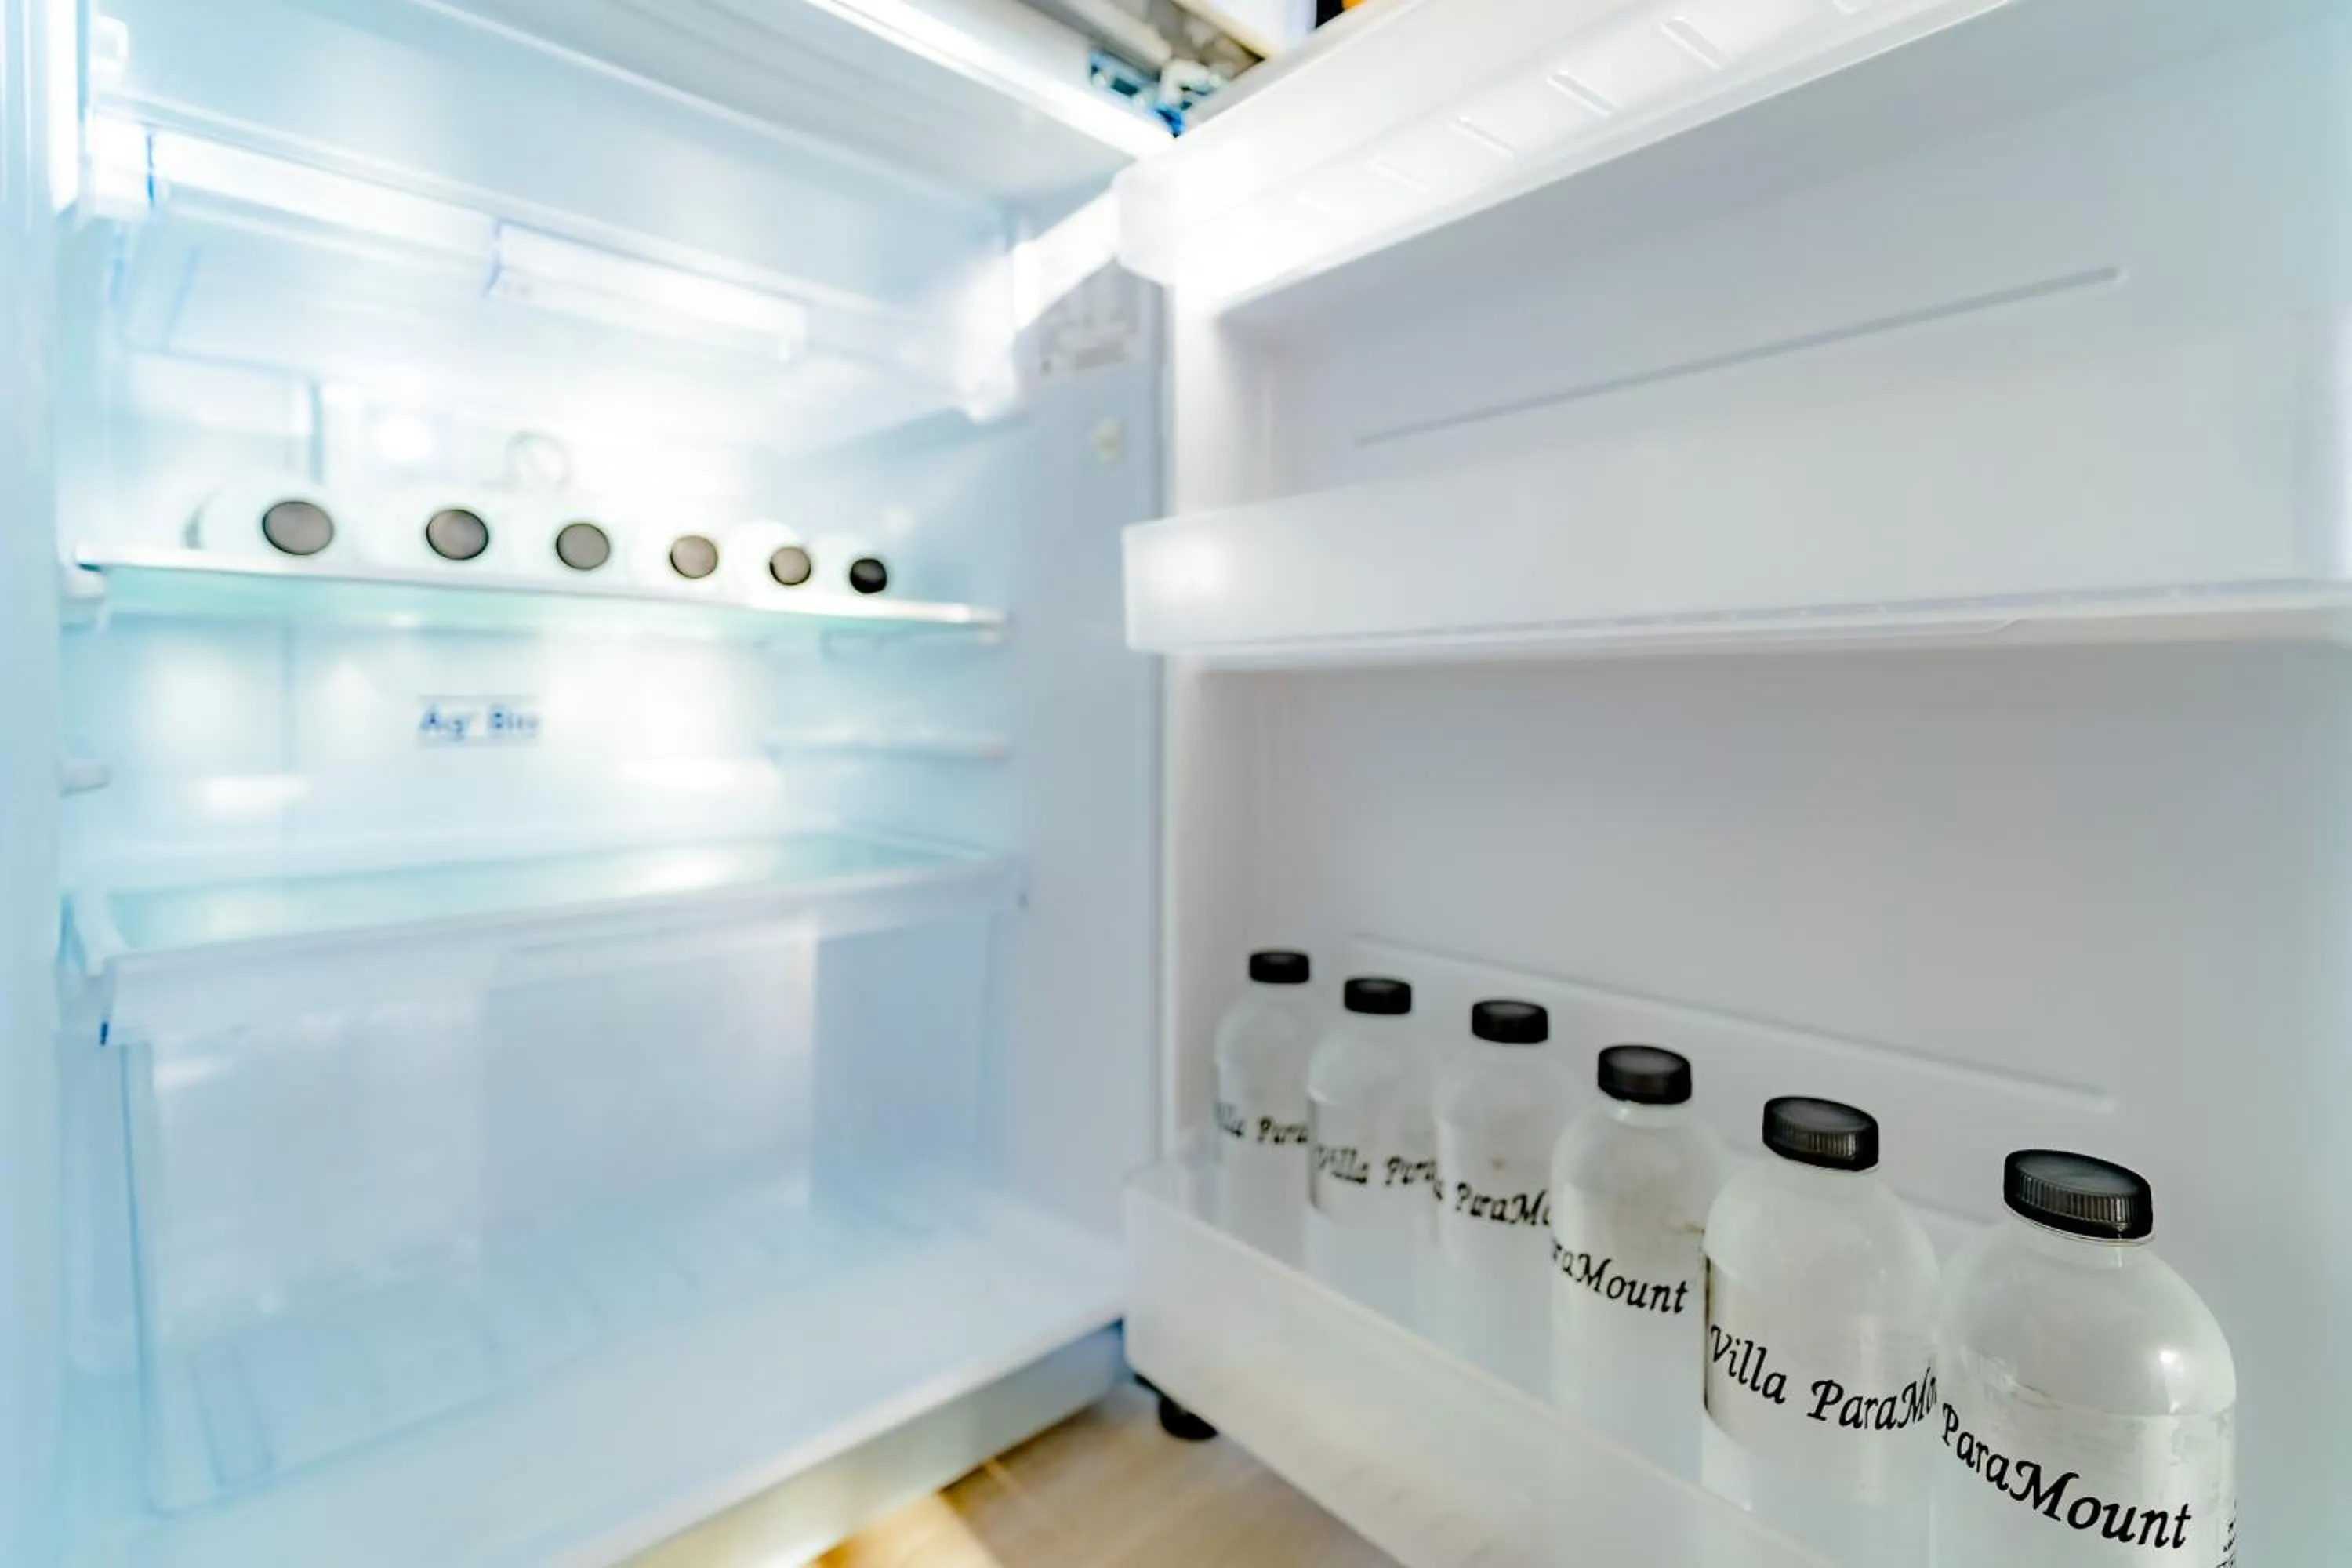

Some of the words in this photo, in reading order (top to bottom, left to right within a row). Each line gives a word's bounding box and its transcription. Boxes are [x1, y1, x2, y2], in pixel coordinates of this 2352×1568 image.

[1552, 1236, 1687, 1314] raMount
[1709, 1323, 1788, 1405] Villa
[1940, 1402, 2193, 1549] ParaMount
